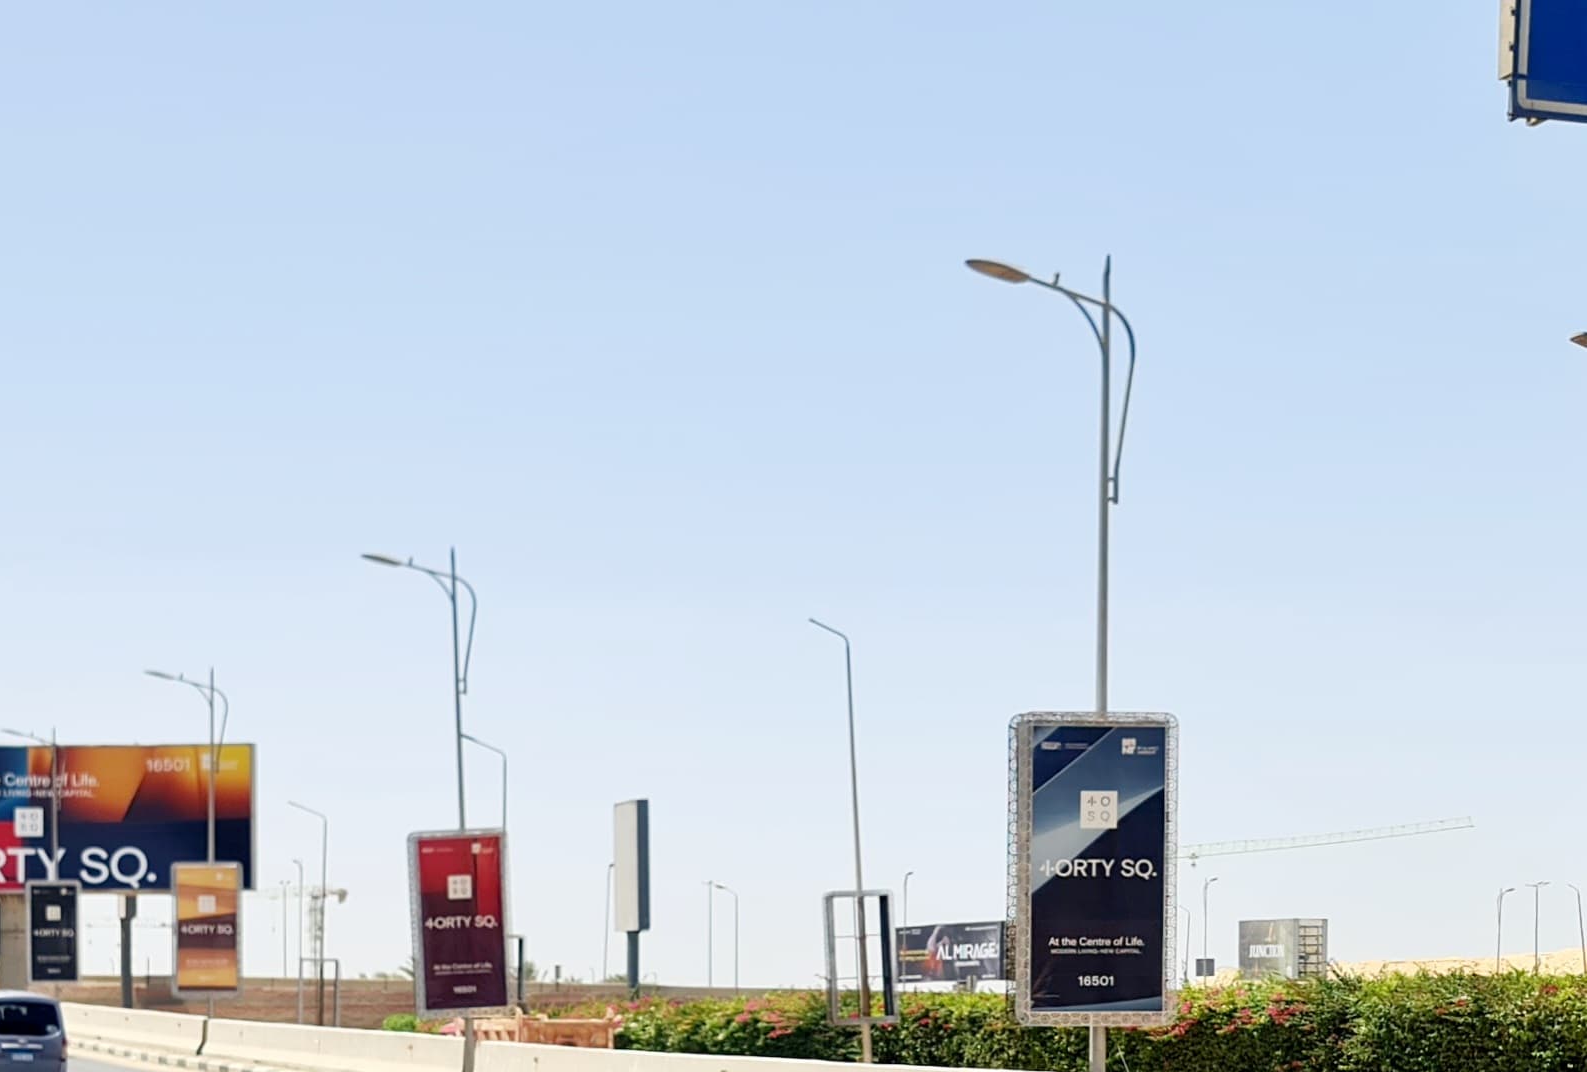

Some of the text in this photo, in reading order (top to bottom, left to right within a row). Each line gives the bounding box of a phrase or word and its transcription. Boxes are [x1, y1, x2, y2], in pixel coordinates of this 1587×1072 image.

[79, 847, 158, 889] SQ.
[1120, 859, 1157, 880] SQ.
[1048, 936, 1145, 946] At the Centre of Life.
[1078, 975, 1114, 986] 16501
